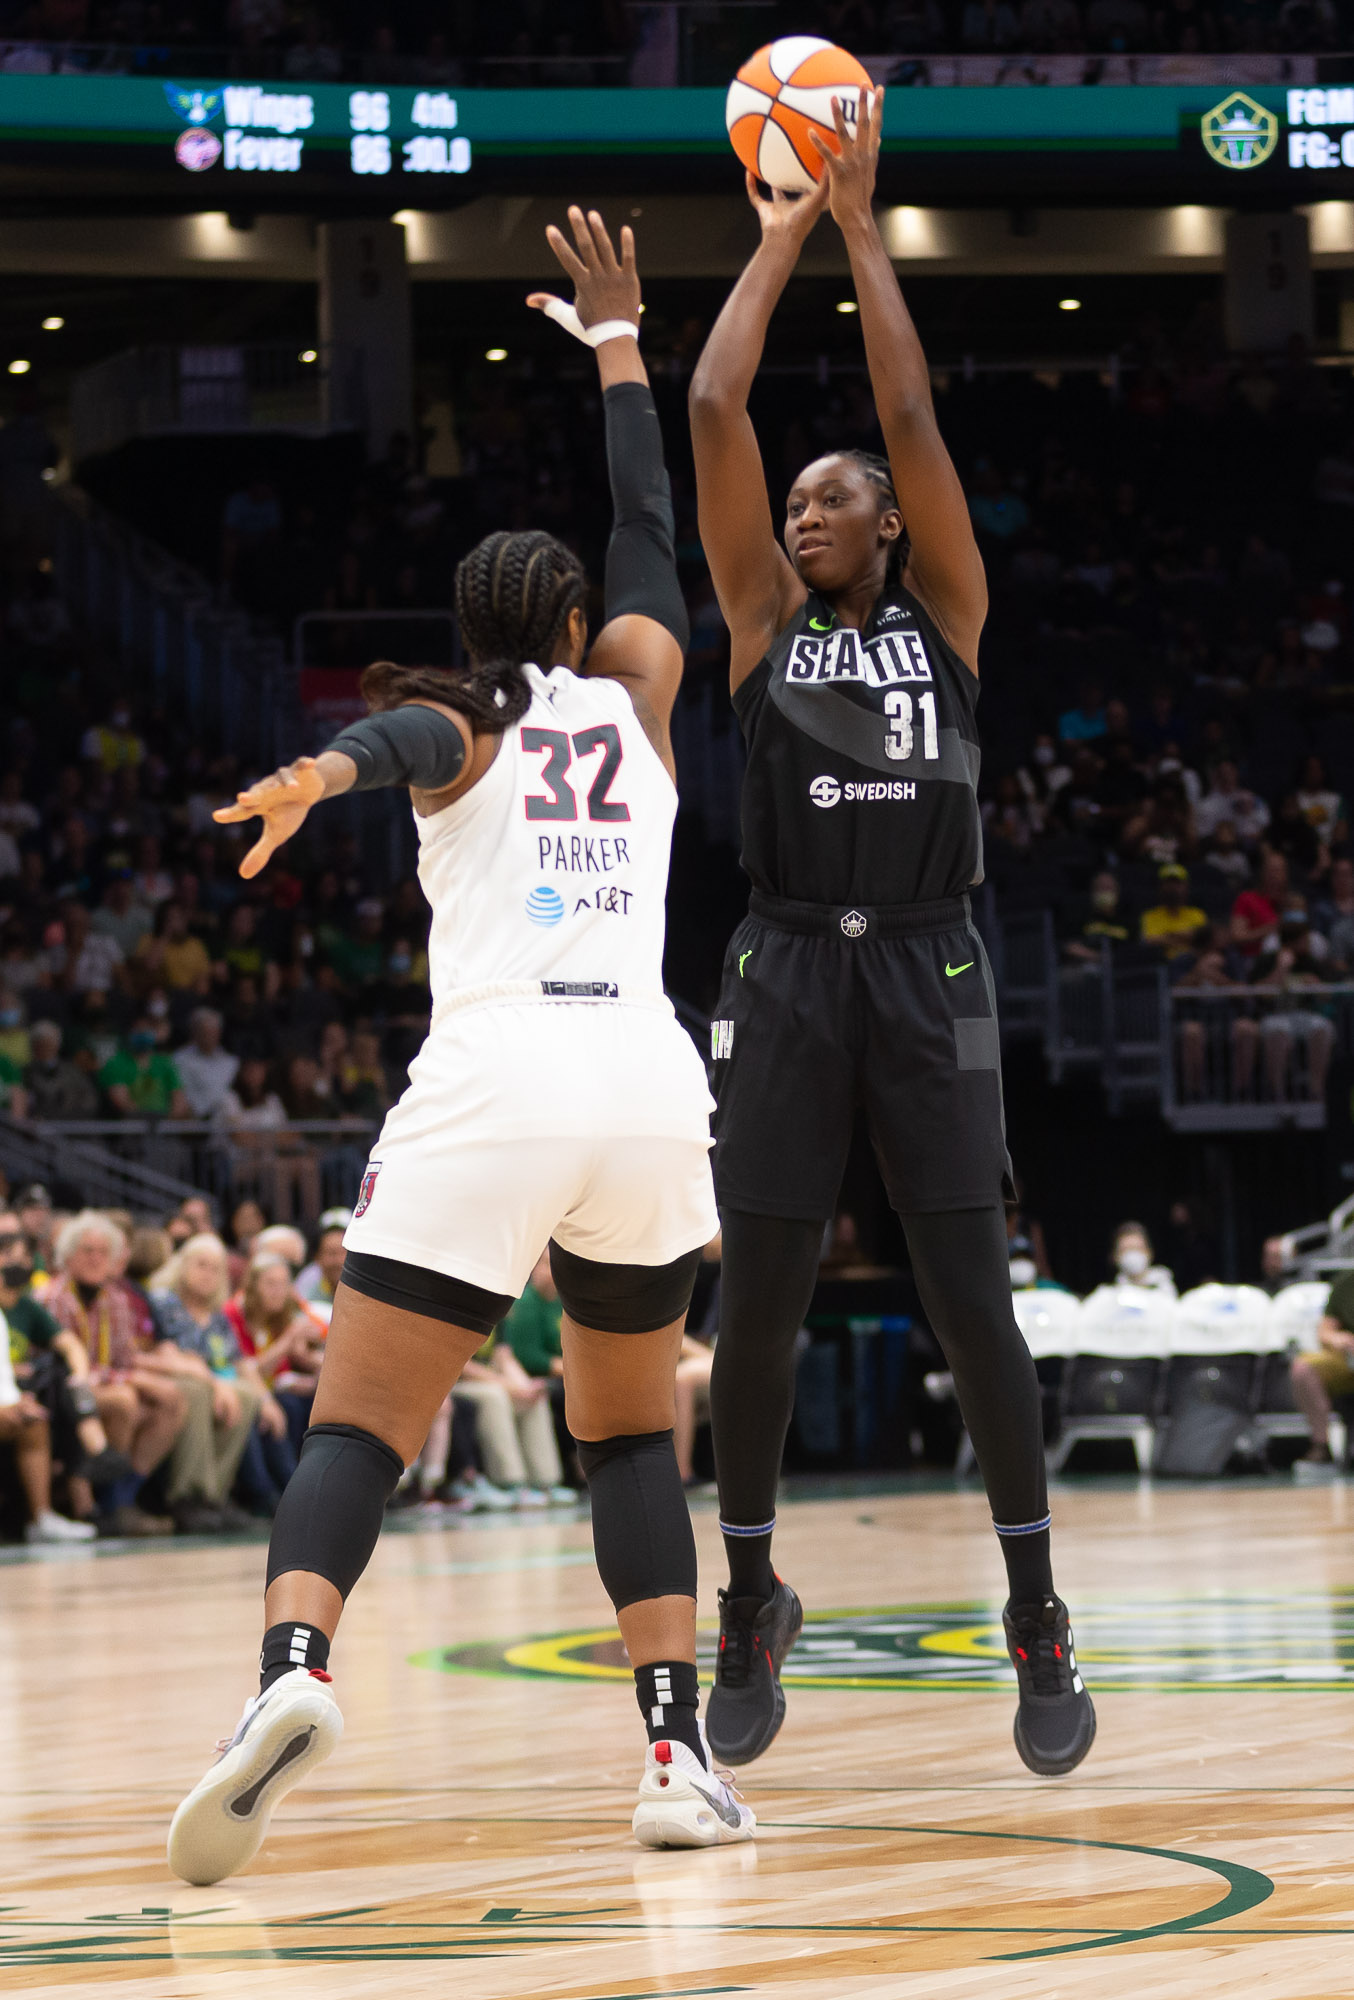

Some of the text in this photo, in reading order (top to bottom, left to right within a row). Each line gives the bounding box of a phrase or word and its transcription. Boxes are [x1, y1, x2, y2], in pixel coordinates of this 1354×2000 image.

[224, 86, 314, 132] Wings
[412, 93, 458, 129] 4th
[225, 130, 304, 172] Fever
[791, 632, 928, 683] SEATLE
[884, 691, 939, 760] 31
[520, 723, 631, 823] 32
[845, 782, 916, 801] SWEDISH
[538, 836, 630, 873] PARKER
